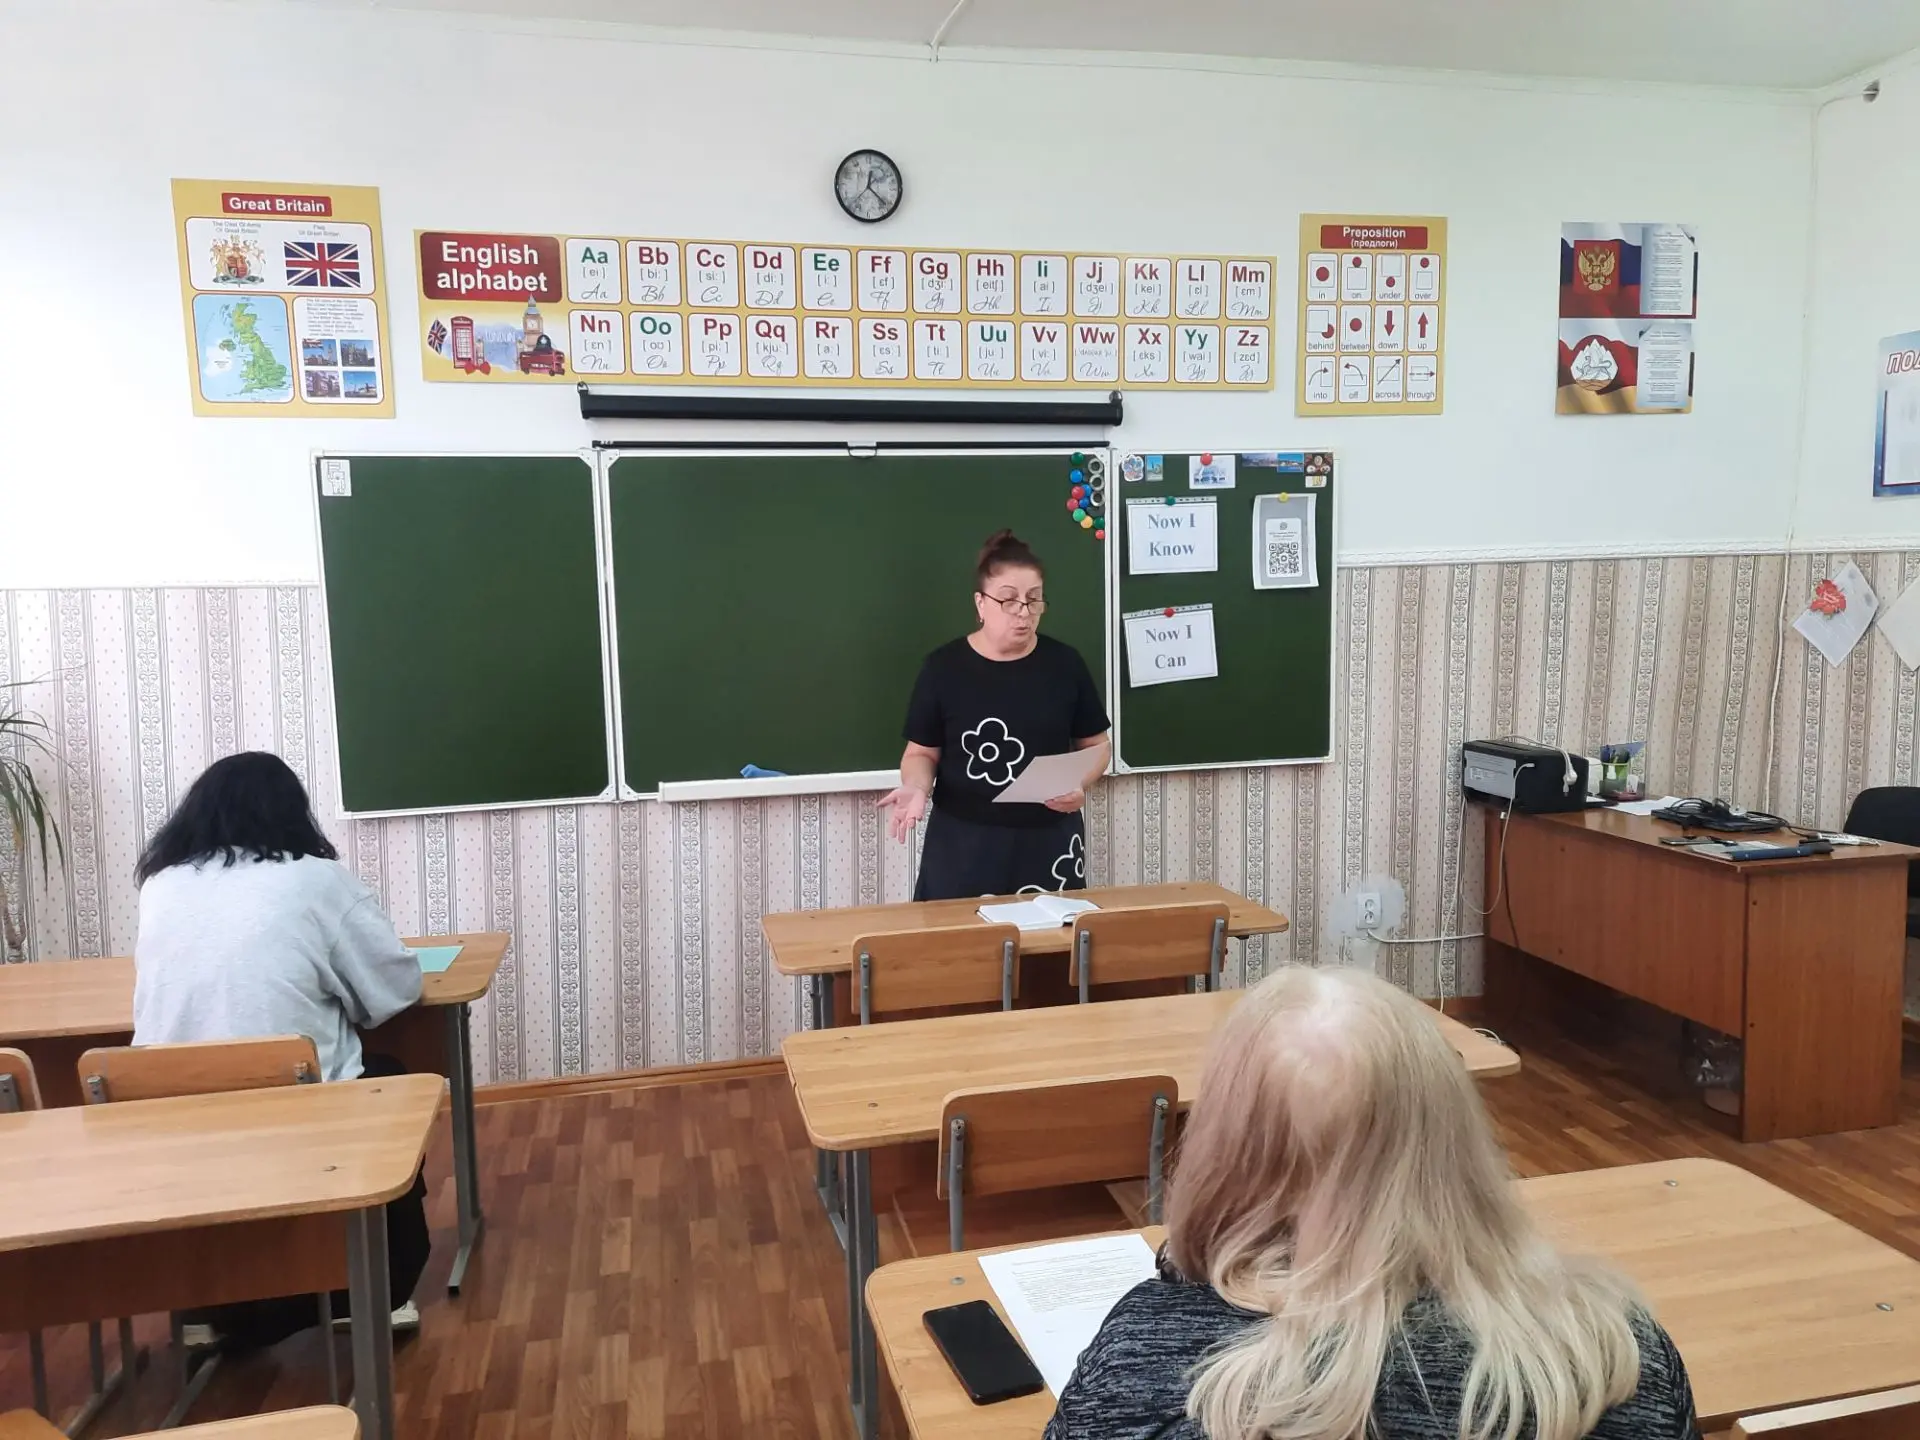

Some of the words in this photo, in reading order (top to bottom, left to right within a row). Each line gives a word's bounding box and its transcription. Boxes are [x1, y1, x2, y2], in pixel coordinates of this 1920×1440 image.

[229, 197, 272, 211] Great
[276, 199, 325, 213] Britain
[1343, 227, 1406, 242] Preposition
[1351, 240, 1398, 249] (предлоги)
[442, 241, 539, 269] English
[581, 247, 609, 264] Aa
[639, 246, 669, 265] Bb
[696, 249, 726, 268] Cc
[753, 251, 782, 269] Dd
[814, 253, 840, 271] Ee
[871, 256, 892, 274] Ff
[919, 257, 949, 280] Gg
[977, 259, 1004, 277] Hh
[1038, 260, 1048, 278] Ii
[1086, 262, 1103, 283] Jj
[1134, 263, 1160, 280] Kk
[1188, 265, 1205, 282] Ll
[437, 268, 548, 294] alphabet
[1232, 266, 1264, 283] Mm
[1318, 291, 1326, 299] in
[580, 314, 611, 333] Nn
[640, 317, 672, 335] Oo
[704, 318, 732, 340] Pp
[755, 320, 786, 342] Qq
[815, 321, 839, 339] Rr
[873, 323, 899, 341] Ss
[925, 324, 946, 341] Tt
[980, 325, 1007, 343] Uu
[1032, 326, 1057, 343] Vv
[1080, 327, 1115, 344] Ww
[1138, 328, 1162, 345] Xx
[1185, 329, 1208, 350] Yy
[1237, 330, 1260, 347] Zz
[1149, 514, 1183, 530] Now
[1190, 513, 1196, 528] I
[1149, 541, 1195, 557] Know
[1145, 629, 1180, 644] Now
[1186, 625, 1192, 639] I
[1155, 654, 1187, 669] Can
